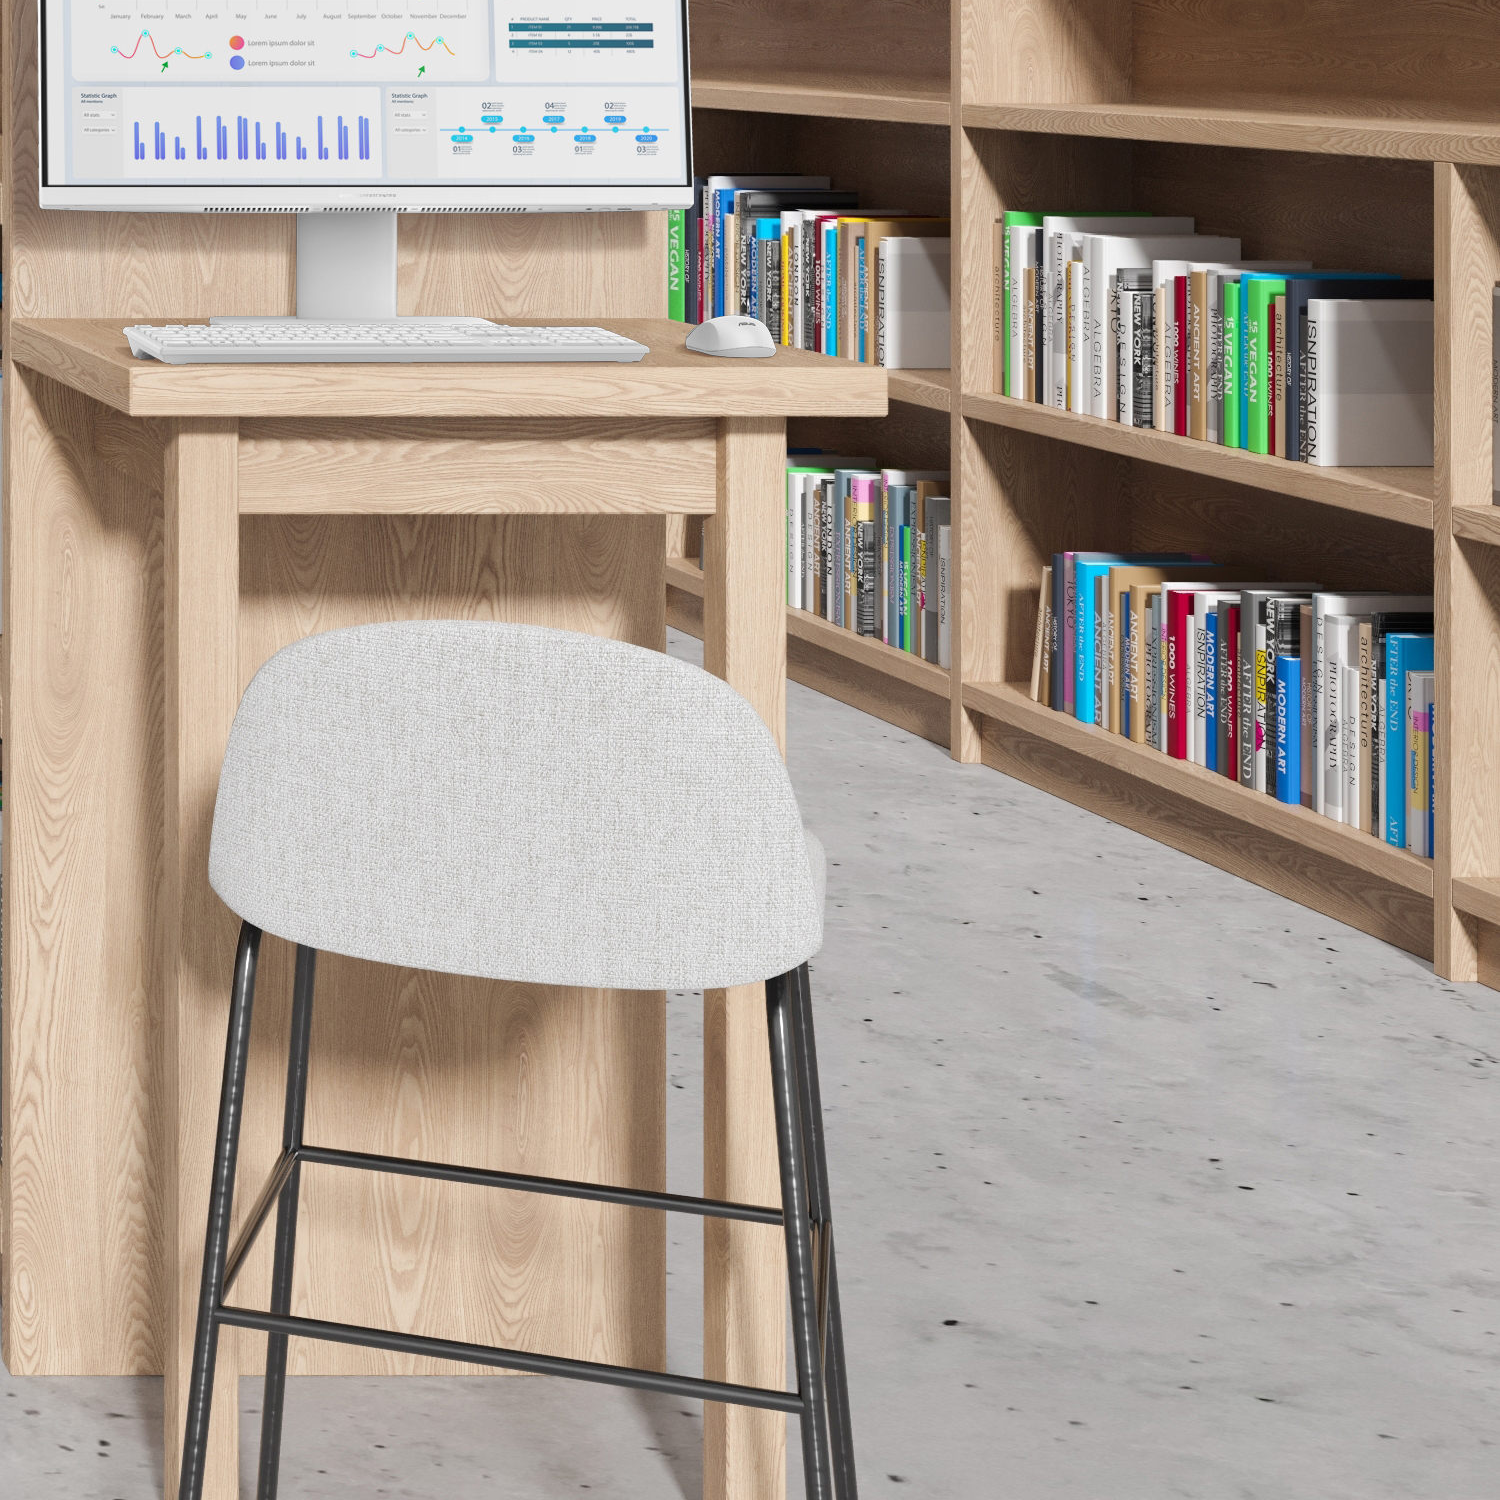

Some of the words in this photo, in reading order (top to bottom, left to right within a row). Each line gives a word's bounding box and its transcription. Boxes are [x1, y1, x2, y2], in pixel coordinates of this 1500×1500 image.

[670, 226, 679, 290] VEGAN
[1133, 295, 1141, 323] NEW
[1094, 319, 1102, 399] ALGEBRA
[1118, 324, 1126, 412] DESIGN
[1133, 326, 1141, 365] YORK
[1308, 321, 1316, 458] ISNPIRATION
[1130, 610, 1138, 672] ANCIENT
[1267, 598, 1275, 636] NEW
[1130, 675, 1138, 702] ART
[1197, 628, 1206, 718] ISNPIRATION
[1206, 630, 1214, 690] MODERN
[1266, 639, 1275, 684] YORK
[1206, 692, 1214, 717] ART
[1256, 650, 1266, 750] ISNPIRATION
[1277, 679, 1286, 744] MODERN
[1329, 661, 1337, 772] PHOTOGRAPHY
[1278, 747, 1286, 774] ART
